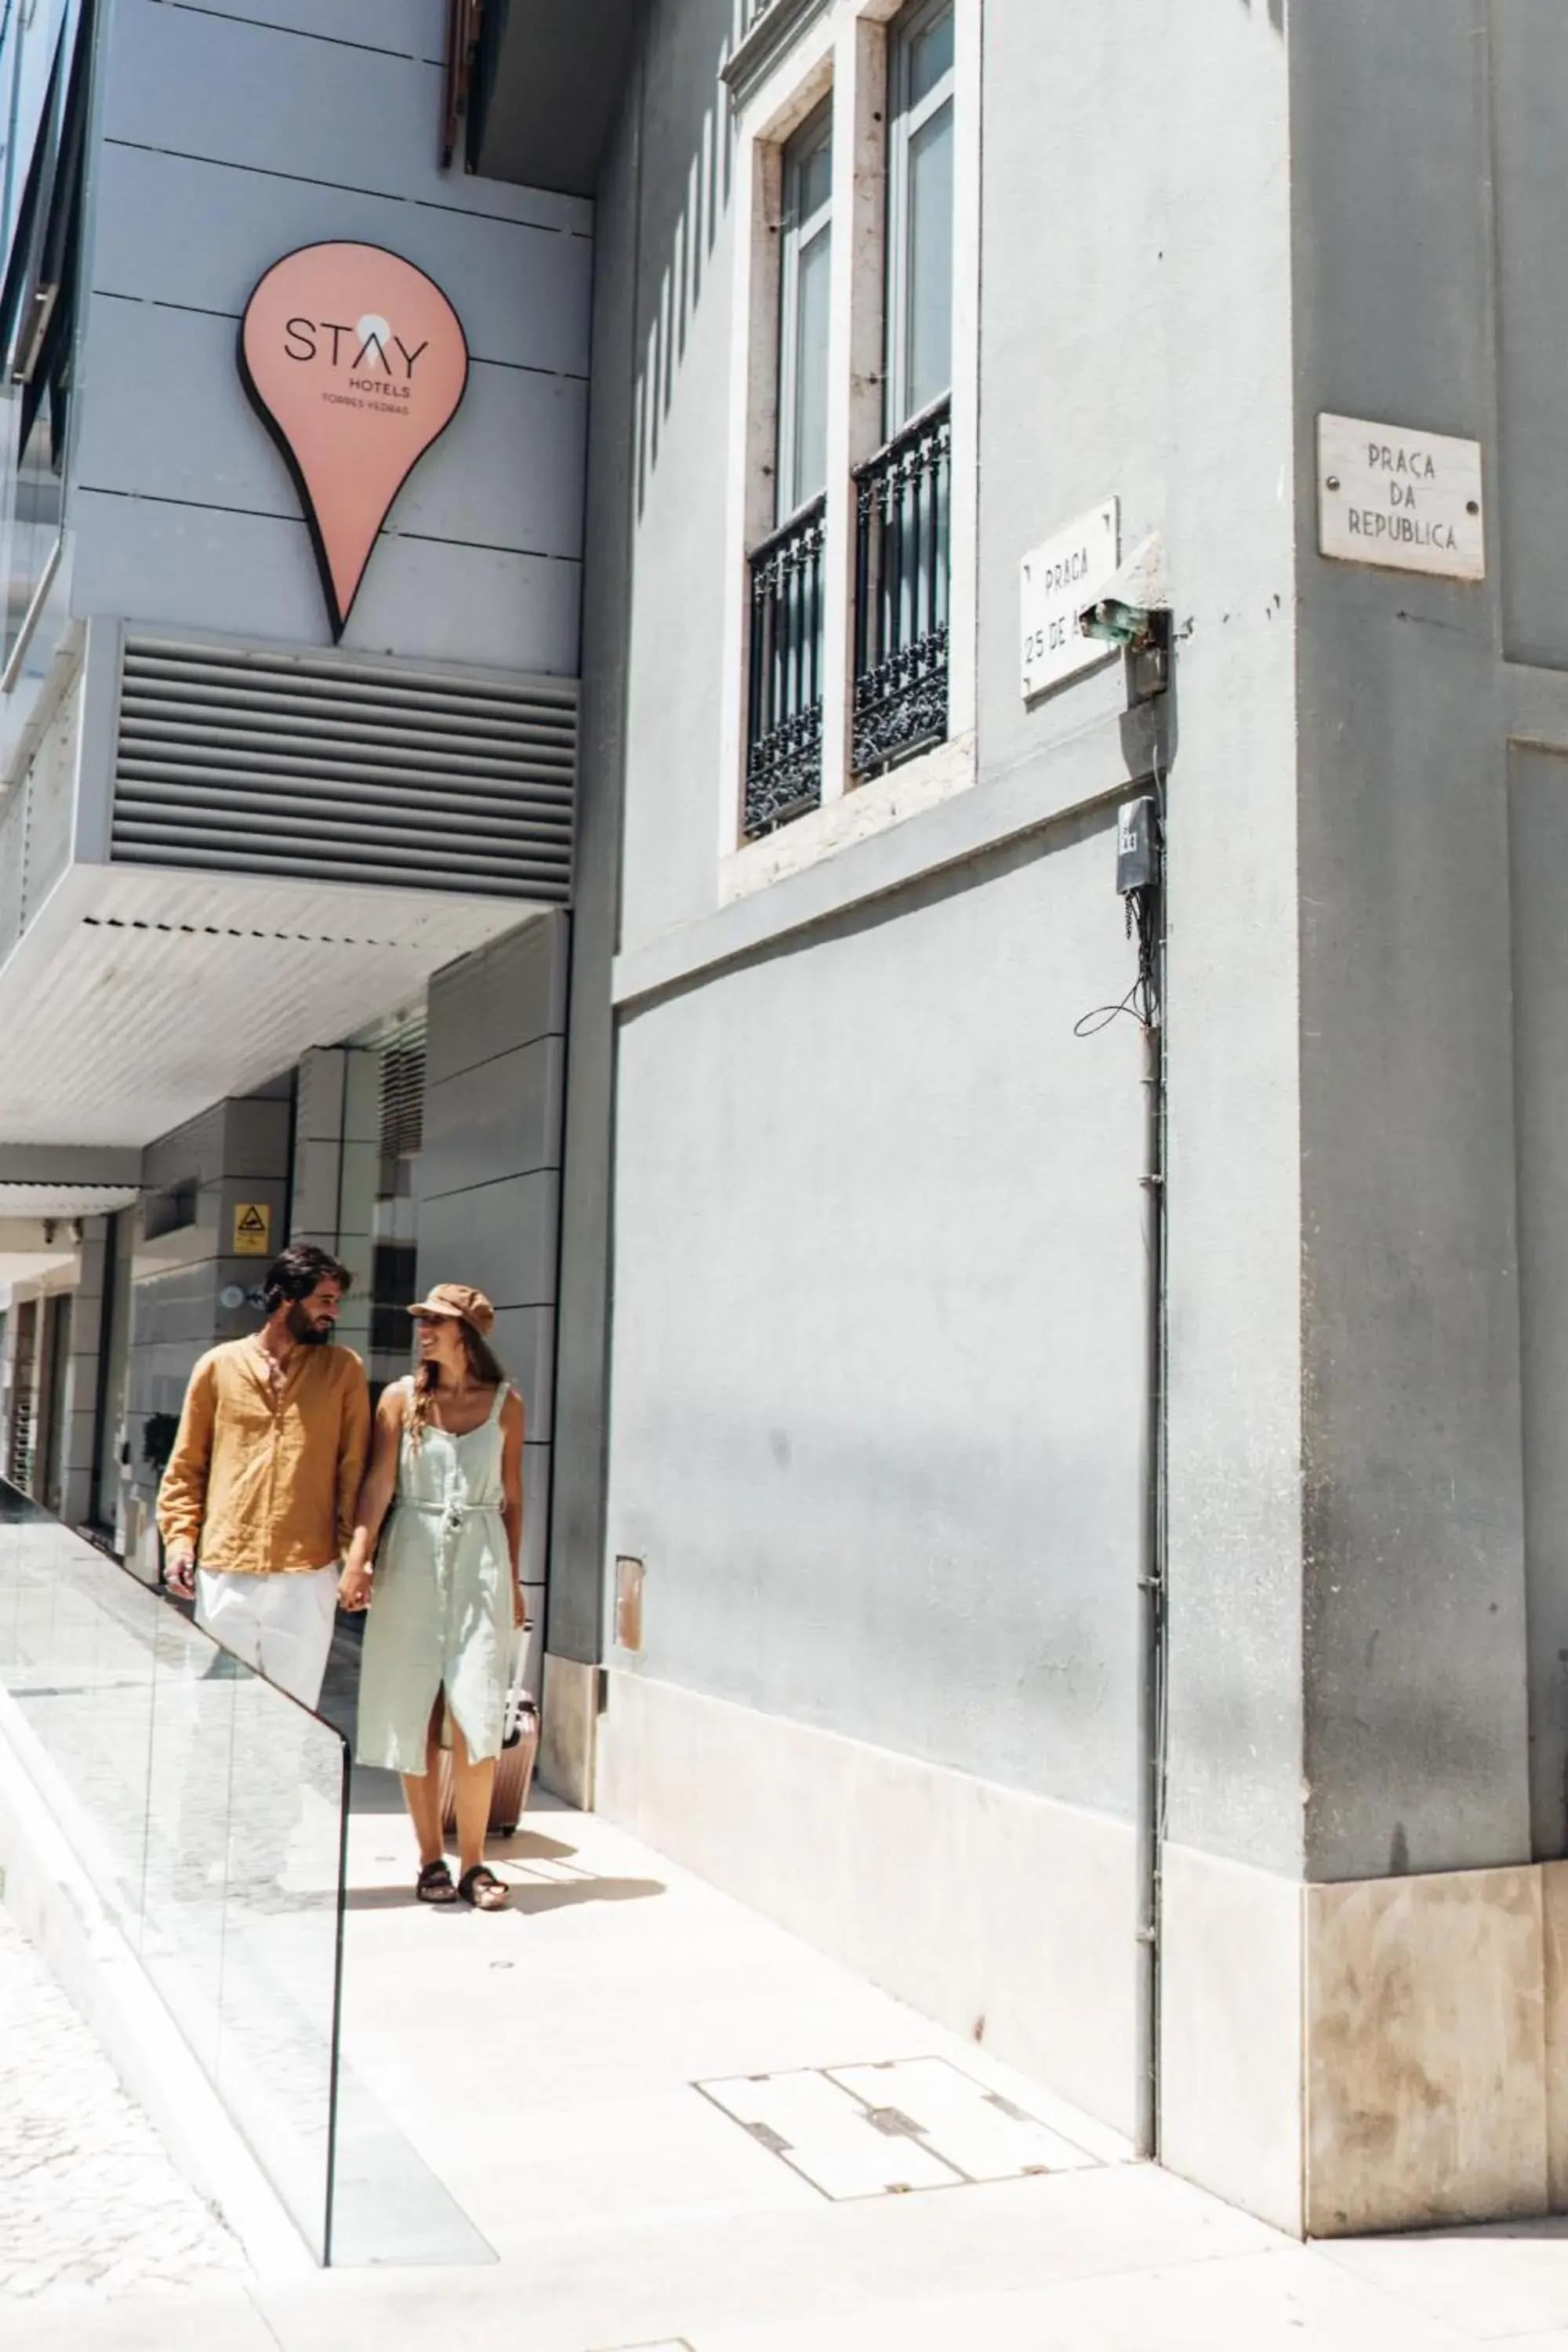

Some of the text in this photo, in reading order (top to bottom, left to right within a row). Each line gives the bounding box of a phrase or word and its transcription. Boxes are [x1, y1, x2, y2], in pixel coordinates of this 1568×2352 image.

[284, 318, 429, 379] STAY
[350, 379, 411, 398] HOTELS
[1389, 479, 1415, 509] DA
[1025, 629, 1044, 664] 25
[1050, 616, 1065, 650] DE
